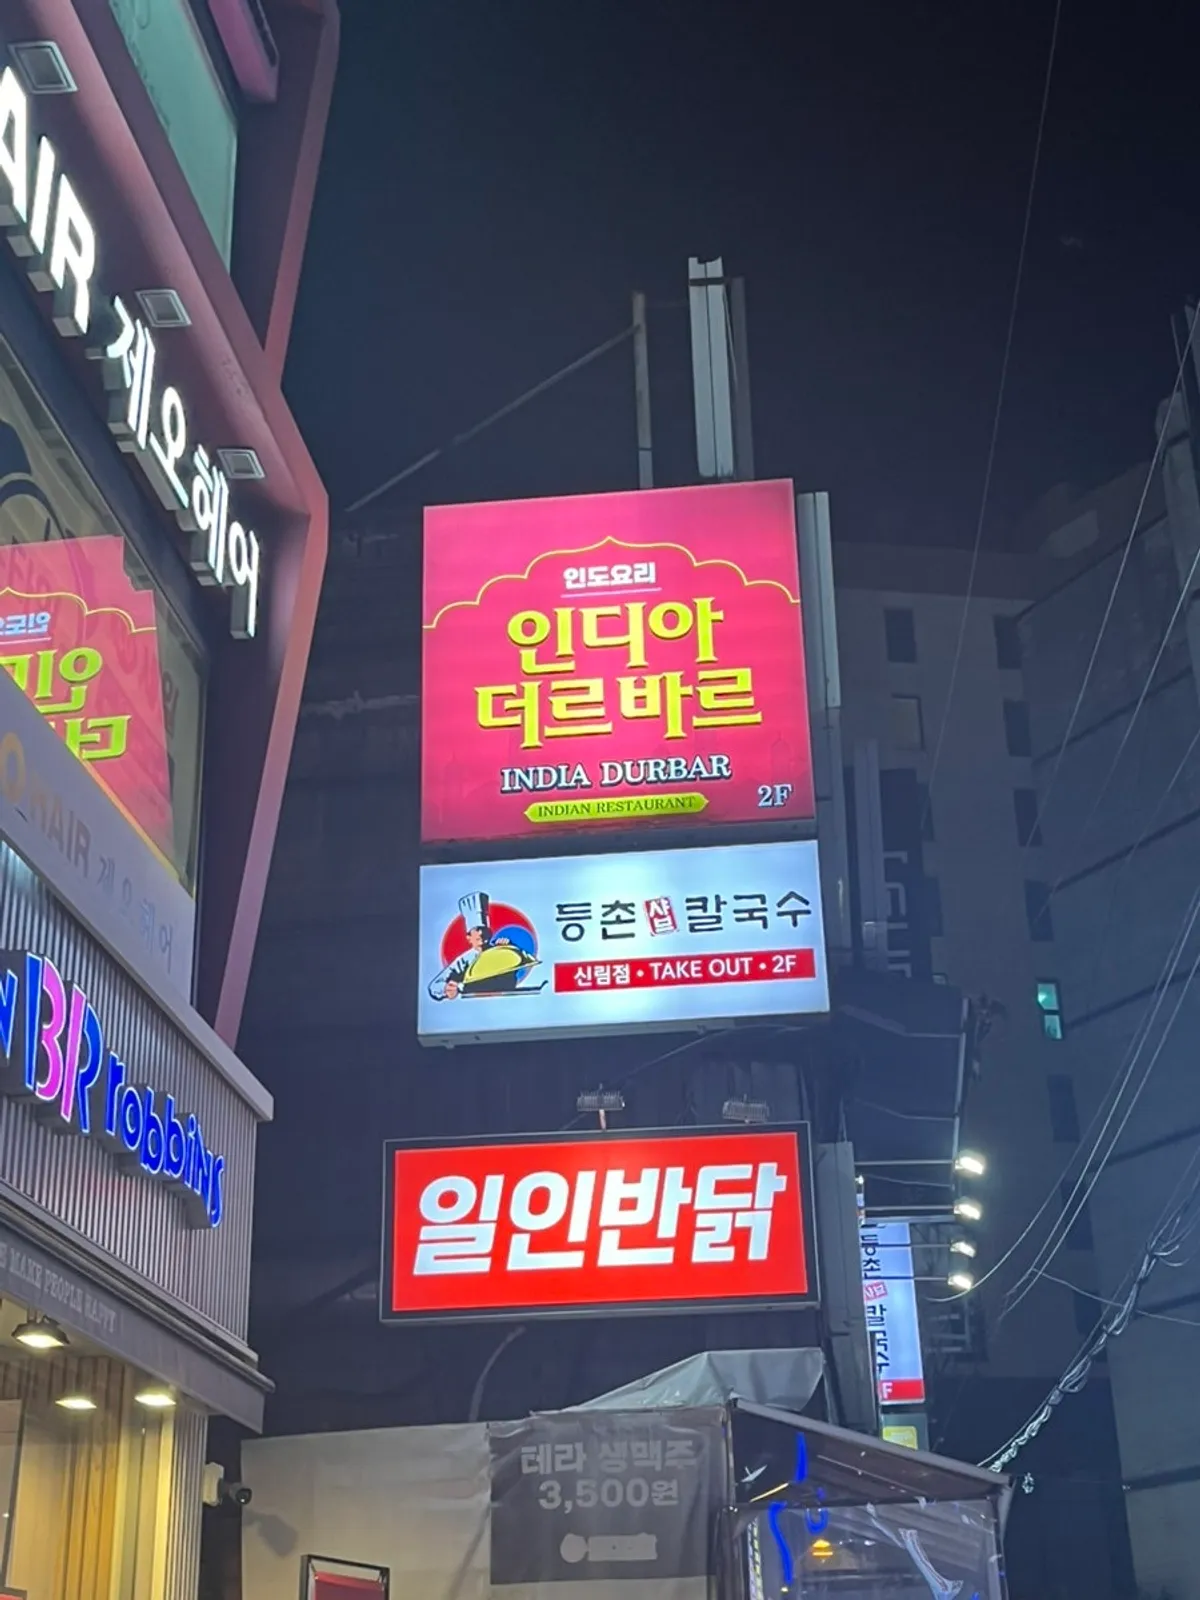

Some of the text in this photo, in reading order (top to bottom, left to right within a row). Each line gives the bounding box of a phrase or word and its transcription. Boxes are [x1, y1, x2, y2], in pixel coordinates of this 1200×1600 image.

[106, 295, 260, 638] 제오헤어
[563, 562, 656, 589] 인도요리
[507, 597, 724, 674] 인디아
[474, 667, 763, 750] 더르바르
[501, 754, 732, 793] INDIA DURBAR
[537, 796, 696, 818] INDIAN RESTAURANT
[757, 783, 793, 809] 2F
[573, 954, 797, 987] 신림점 TAKE OUT 2F
[26, 952, 103, 1133] BR
[413, 1162, 787, 1276] 일인반닭
[521, 1438, 697, 1475] 테라 생맥주
[538, 1478, 681, 1514] 3,500원
